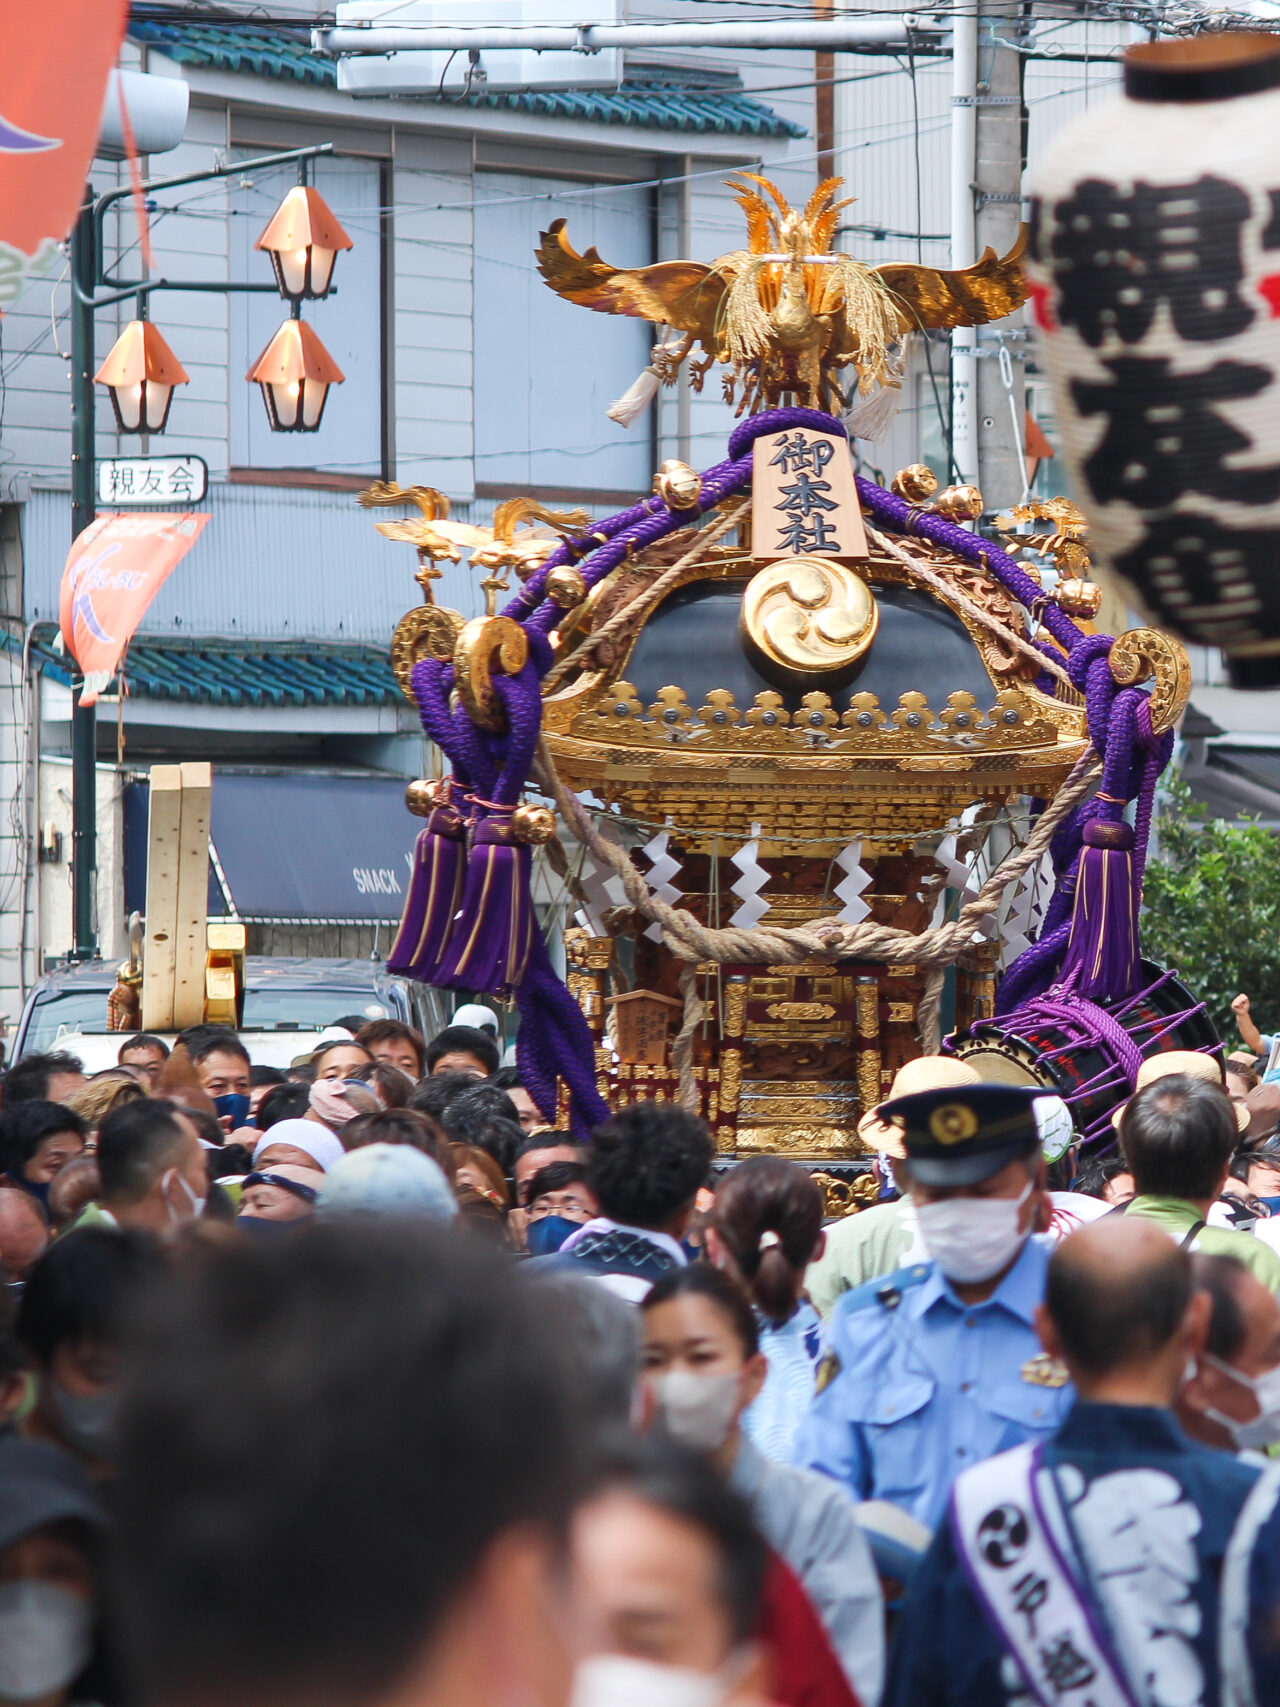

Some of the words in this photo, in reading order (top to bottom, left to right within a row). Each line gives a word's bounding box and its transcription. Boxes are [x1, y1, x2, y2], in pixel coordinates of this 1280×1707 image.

[109, 465, 194, 497] 親友会
[769, 432, 842, 554] 御本社
[352, 867, 402, 894] SNACK
[1010, 1572, 1098, 1707] 戸越
